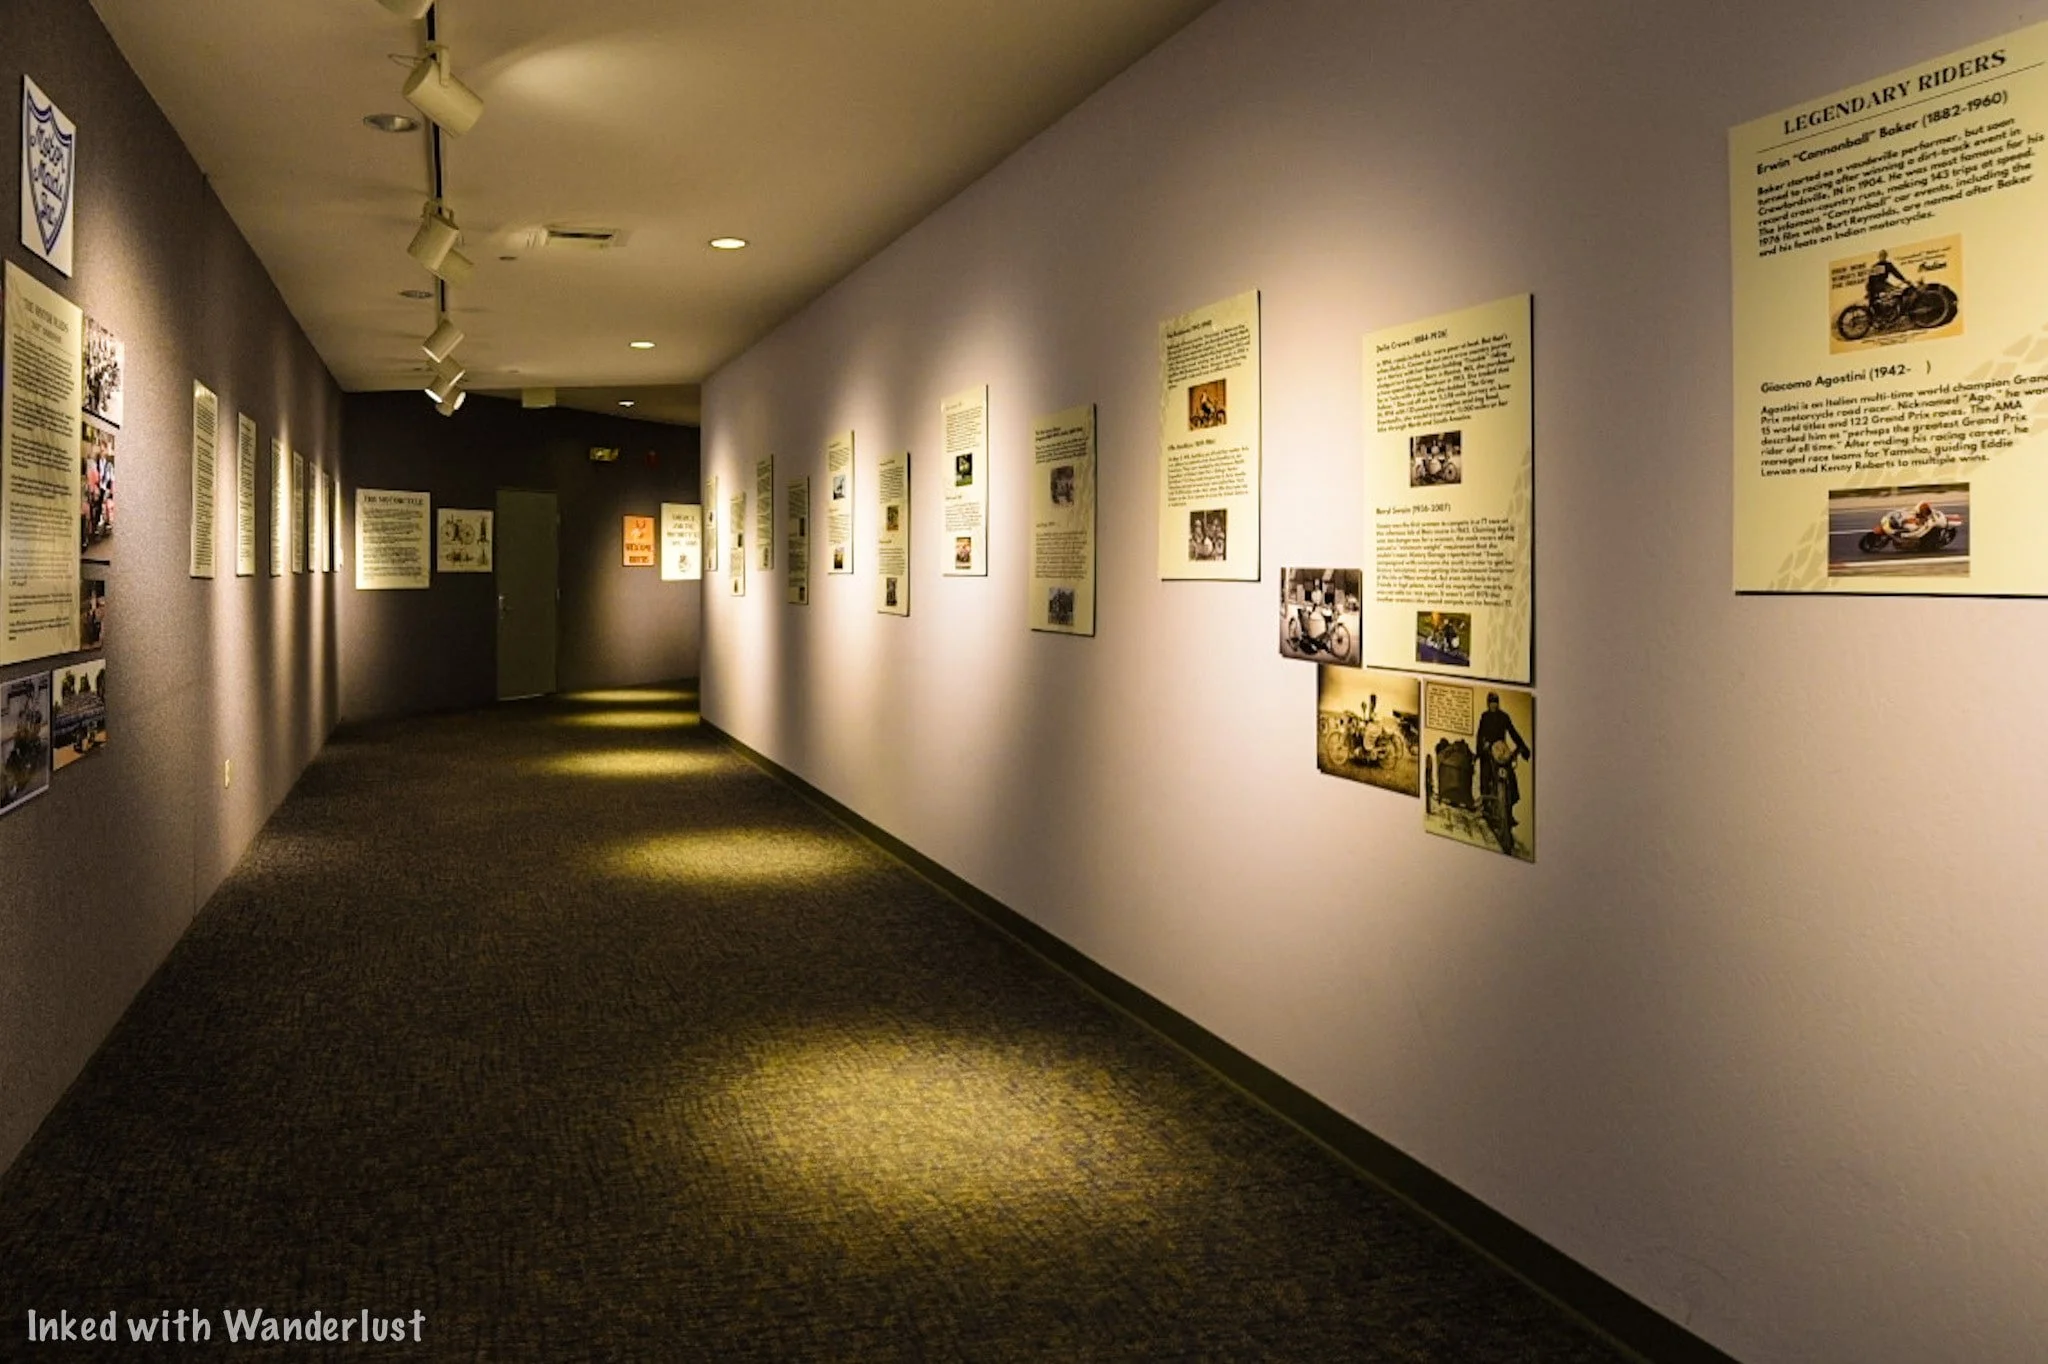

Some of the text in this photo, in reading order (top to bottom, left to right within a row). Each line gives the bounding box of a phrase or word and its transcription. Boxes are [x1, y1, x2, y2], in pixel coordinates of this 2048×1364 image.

[1784, 46, 2007, 135] LEGENDARY RIDERS
[1757, 87, 2008, 175] Erwin "Cannonball" Baker (1882-1960)
[1757, 183, 1783, 196] Baker
[1787, 170, 1820, 187] started
[1823, 169, 1833, 177] as
[1846, 149, 1898, 170] vaudeville
[1902, 133, 1961, 157] performer,
[1965, 122, 1984, 137] but
[1986, 116, 2015, 130] soon
[1757, 190, 1788, 206] turned
[1790, 188, 1799, 196] to
[1802, 180, 1833, 193] racing
[1835, 173, 1858, 184] after
[1863, 160, 1904, 176] winning
[1917, 138, 1969, 161] dirt-track
[1974, 128, 2006, 146] event
[2009, 126, 2021, 136] in
[1833, 185, 1843, 196] IN
[1846, 184, 1855, 192] in
[1858, 174, 1886, 189] 1904.
[1888, 171, 1901, 181] He
[1905, 165, 1927, 176] was
[1930, 154, 1957, 169] most
[1961, 144, 2003, 161] famous
[2006, 139, 2022, 149] for
[2027, 132, 2044, 144] his
[1758, 146, 2034, 226] record cross-country runs, making 143 trips at speed.
[1759, 226, 1774, 236] The
[1894, 193, 1910, 202] car
[1914, 181, 1953, 197] events,
[1955, 167, 2009, 186] including
[2012, 160, 2031, 172] the
[1783, 231, 1799, 240] film
[1803, 223, 1823, 236] with
[1826, 217, 1847, 230] Burt
[1850, 206, 1899, 224] Reynolds,
[1902, 201, 1920, 211] are
[1923, 188, 1962, 206] named
[1965, 183, 1992, 196] after
[1997, 174, 2032, 188] Baker
[1759, 211, 1935, 257] and his feats on Indian motorcycles.
[1760, 379, 1811, 392] Giacomo
[1815, 369, 1865, 387] Agostini
[1869, 363, 1911, 381] (1942-
[1761, 402, 1799, 416] Agostini
[1826, 396, 1856, 406] Italian
[1860, 390, 1913, 402] multi-time
[1917, 383, 1949, 395] world
[1952, 378, 2009, 391] champion
[1760, 433, 1805, 445] described
[1808, 432, 1826, 440] him
[1842, 427, 1889, 439] "perhaps
[1893, 423, 1909, 432] the
[1913, 418, 1959, 433] greatest
[1962, 414, 1998, 426] Grand
[2003, 412, 2027, 422] Prix
[1761, 416, 1778, 424] Prix
[1782, 409, 1833, 422] motorcycle
[1837, 406, 1860, 416] road
[1864, 405, 1894, 413] racer.
[1897, 394, 1959, 409] Nicknamed
[2005, 388, 2020, 397] he
[1761, 399, 2022, 434] 15 world titles and 122 Grand Prix races. The AMA
[1761, 447, 1783, 455] rider
[1786, 445, 1795, 453] of
[1798, 444, 1809, 452] all
[1844, 439, 1869, 448] After
[1873, 436, 1908, 446] ending
[1912, 433, 1926, 442] his
[1930, 431, 1965, 441] racing
[1969, 428, 2010, 437] career,
[2014, 424, 2028, 433] he
[1761, 455, 1805, 466] managed
[1831, 452, 1861, 460] teams
[1864, 449, 1879, 457] for
[1882, 445, 1931, 456] Yamaha,
[1934, 441, 1977, 454] guiding
[1980, 438, 2013, 448] Eddie
[1761, 452, 1989, 476] Lawson and Kenny Roberts to multiple wins.
